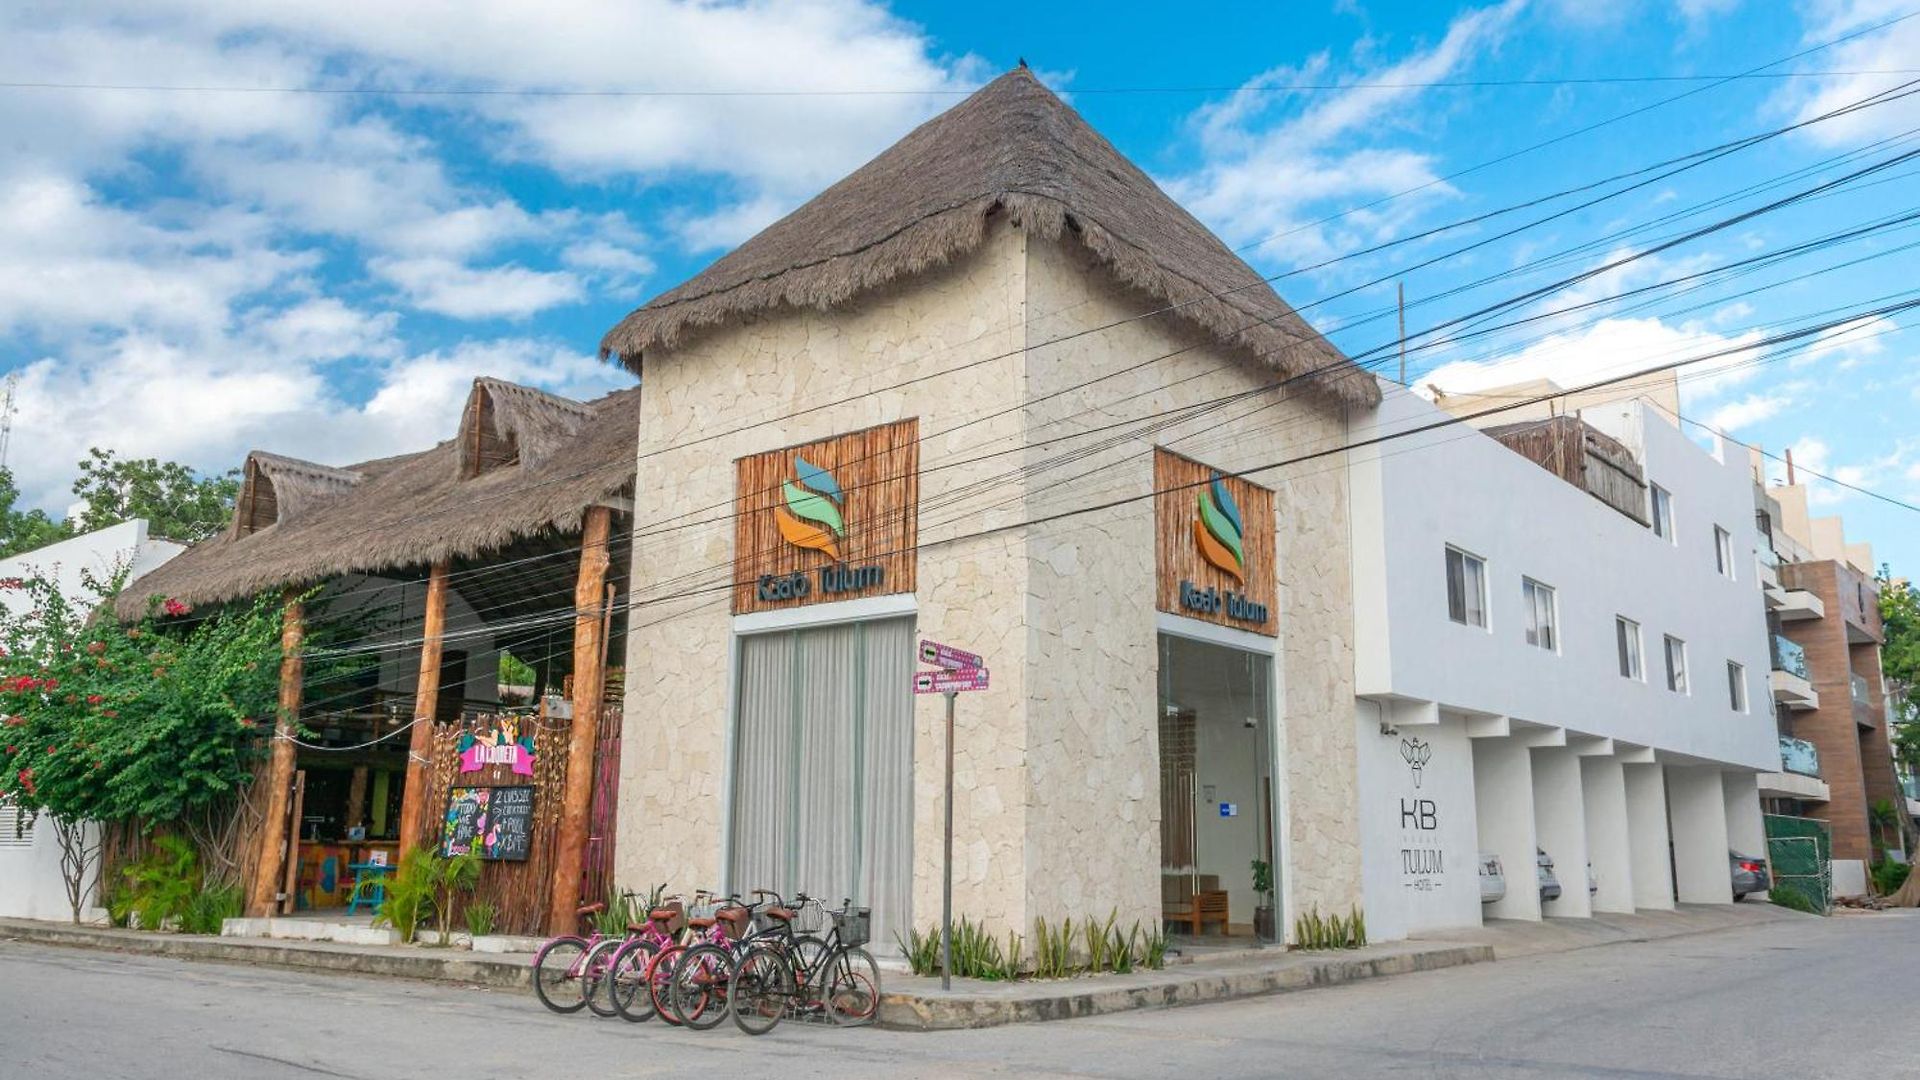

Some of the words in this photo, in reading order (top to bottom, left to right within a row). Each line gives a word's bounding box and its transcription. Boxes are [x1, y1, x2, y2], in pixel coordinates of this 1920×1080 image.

[820, 562, 884, 593] Tulum
[1223, 591, 1267, 624] Tulum
[1401, 798, 1437, 830] KB
[1401, 849, 1444, 875] TULUM
